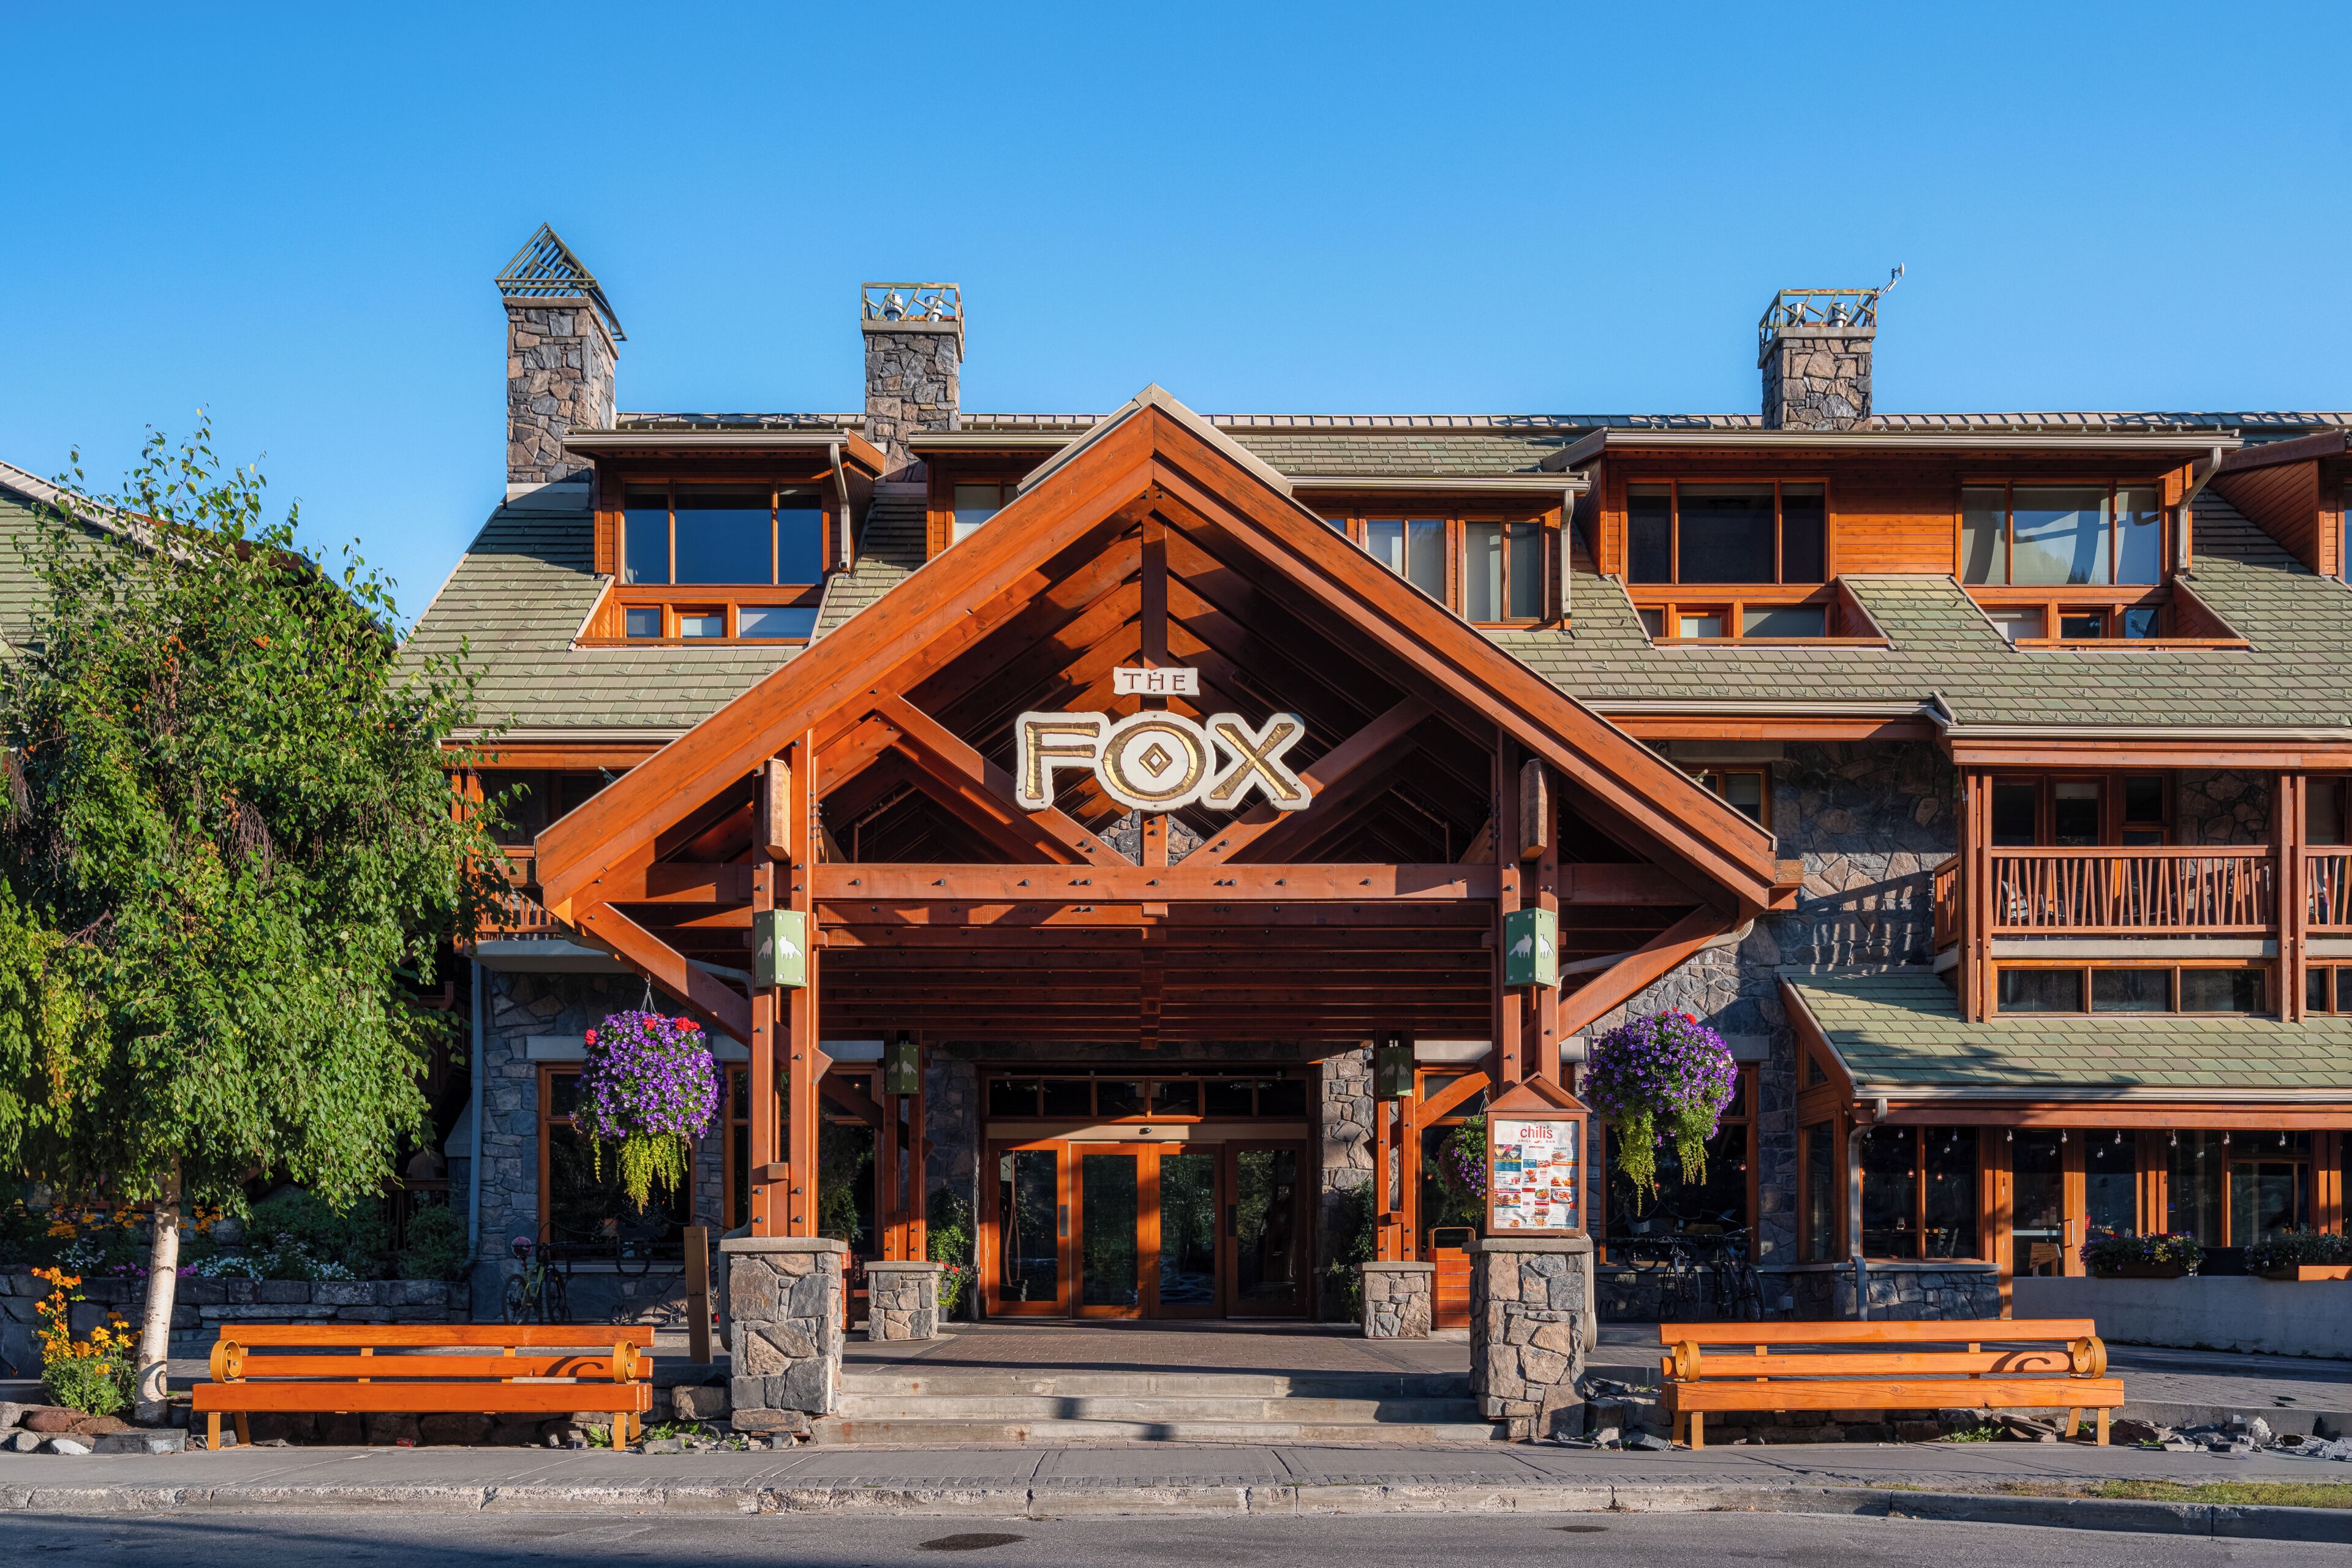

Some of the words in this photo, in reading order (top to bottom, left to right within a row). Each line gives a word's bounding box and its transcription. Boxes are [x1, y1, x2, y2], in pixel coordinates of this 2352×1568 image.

[1123, 673, 1186, 692] THE
[1025, 720, 1302, 802] FOX
[1520, 1125, 1553, 1139] chili's
